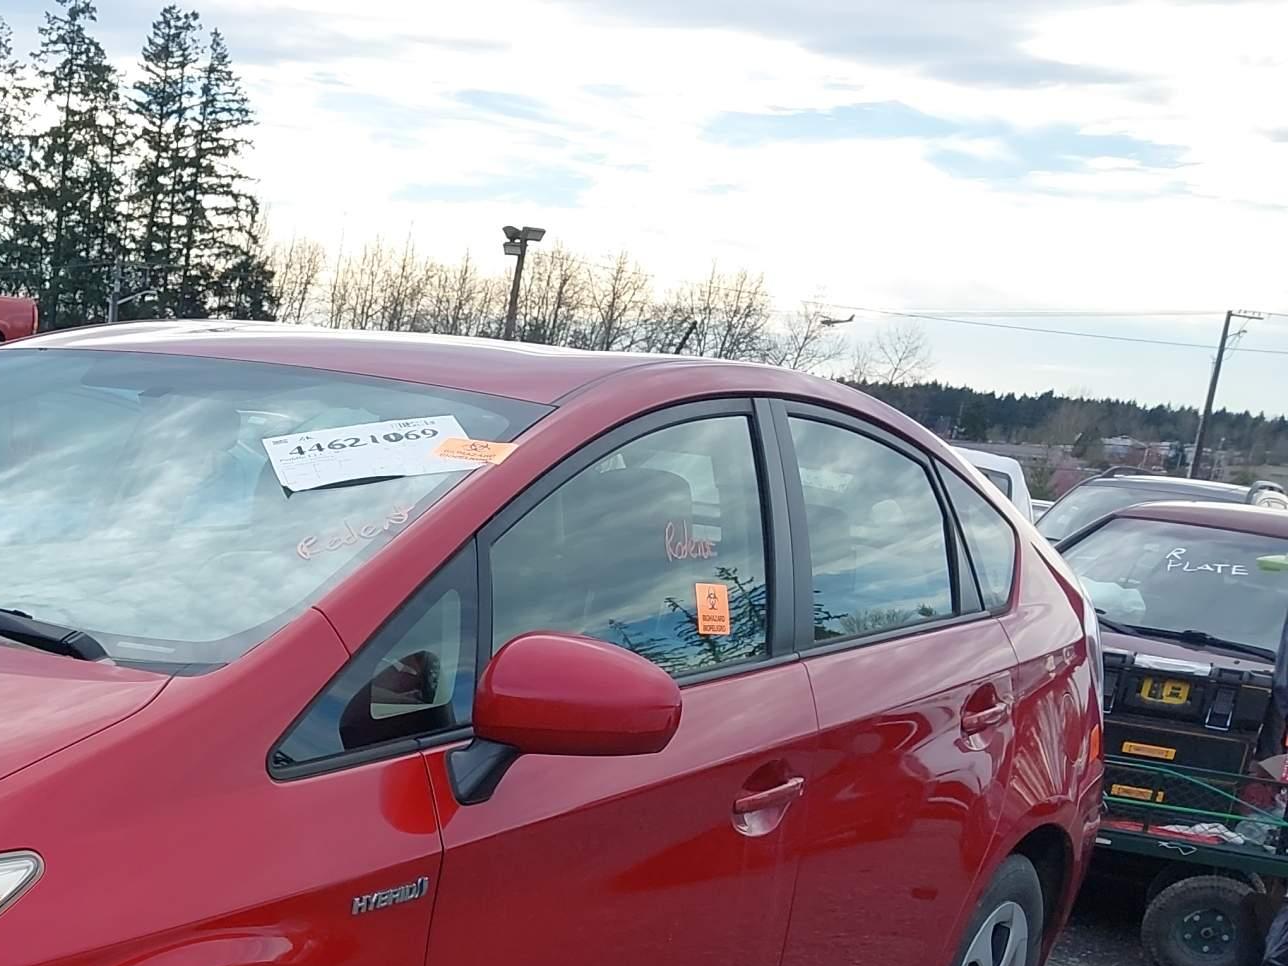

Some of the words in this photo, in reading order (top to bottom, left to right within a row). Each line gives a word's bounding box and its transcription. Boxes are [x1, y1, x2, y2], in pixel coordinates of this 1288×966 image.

[288, 428, 440, 457] 44621069
[1165, 548, 1187, 560] R
[351, 878, 426, 915] HYBRID
